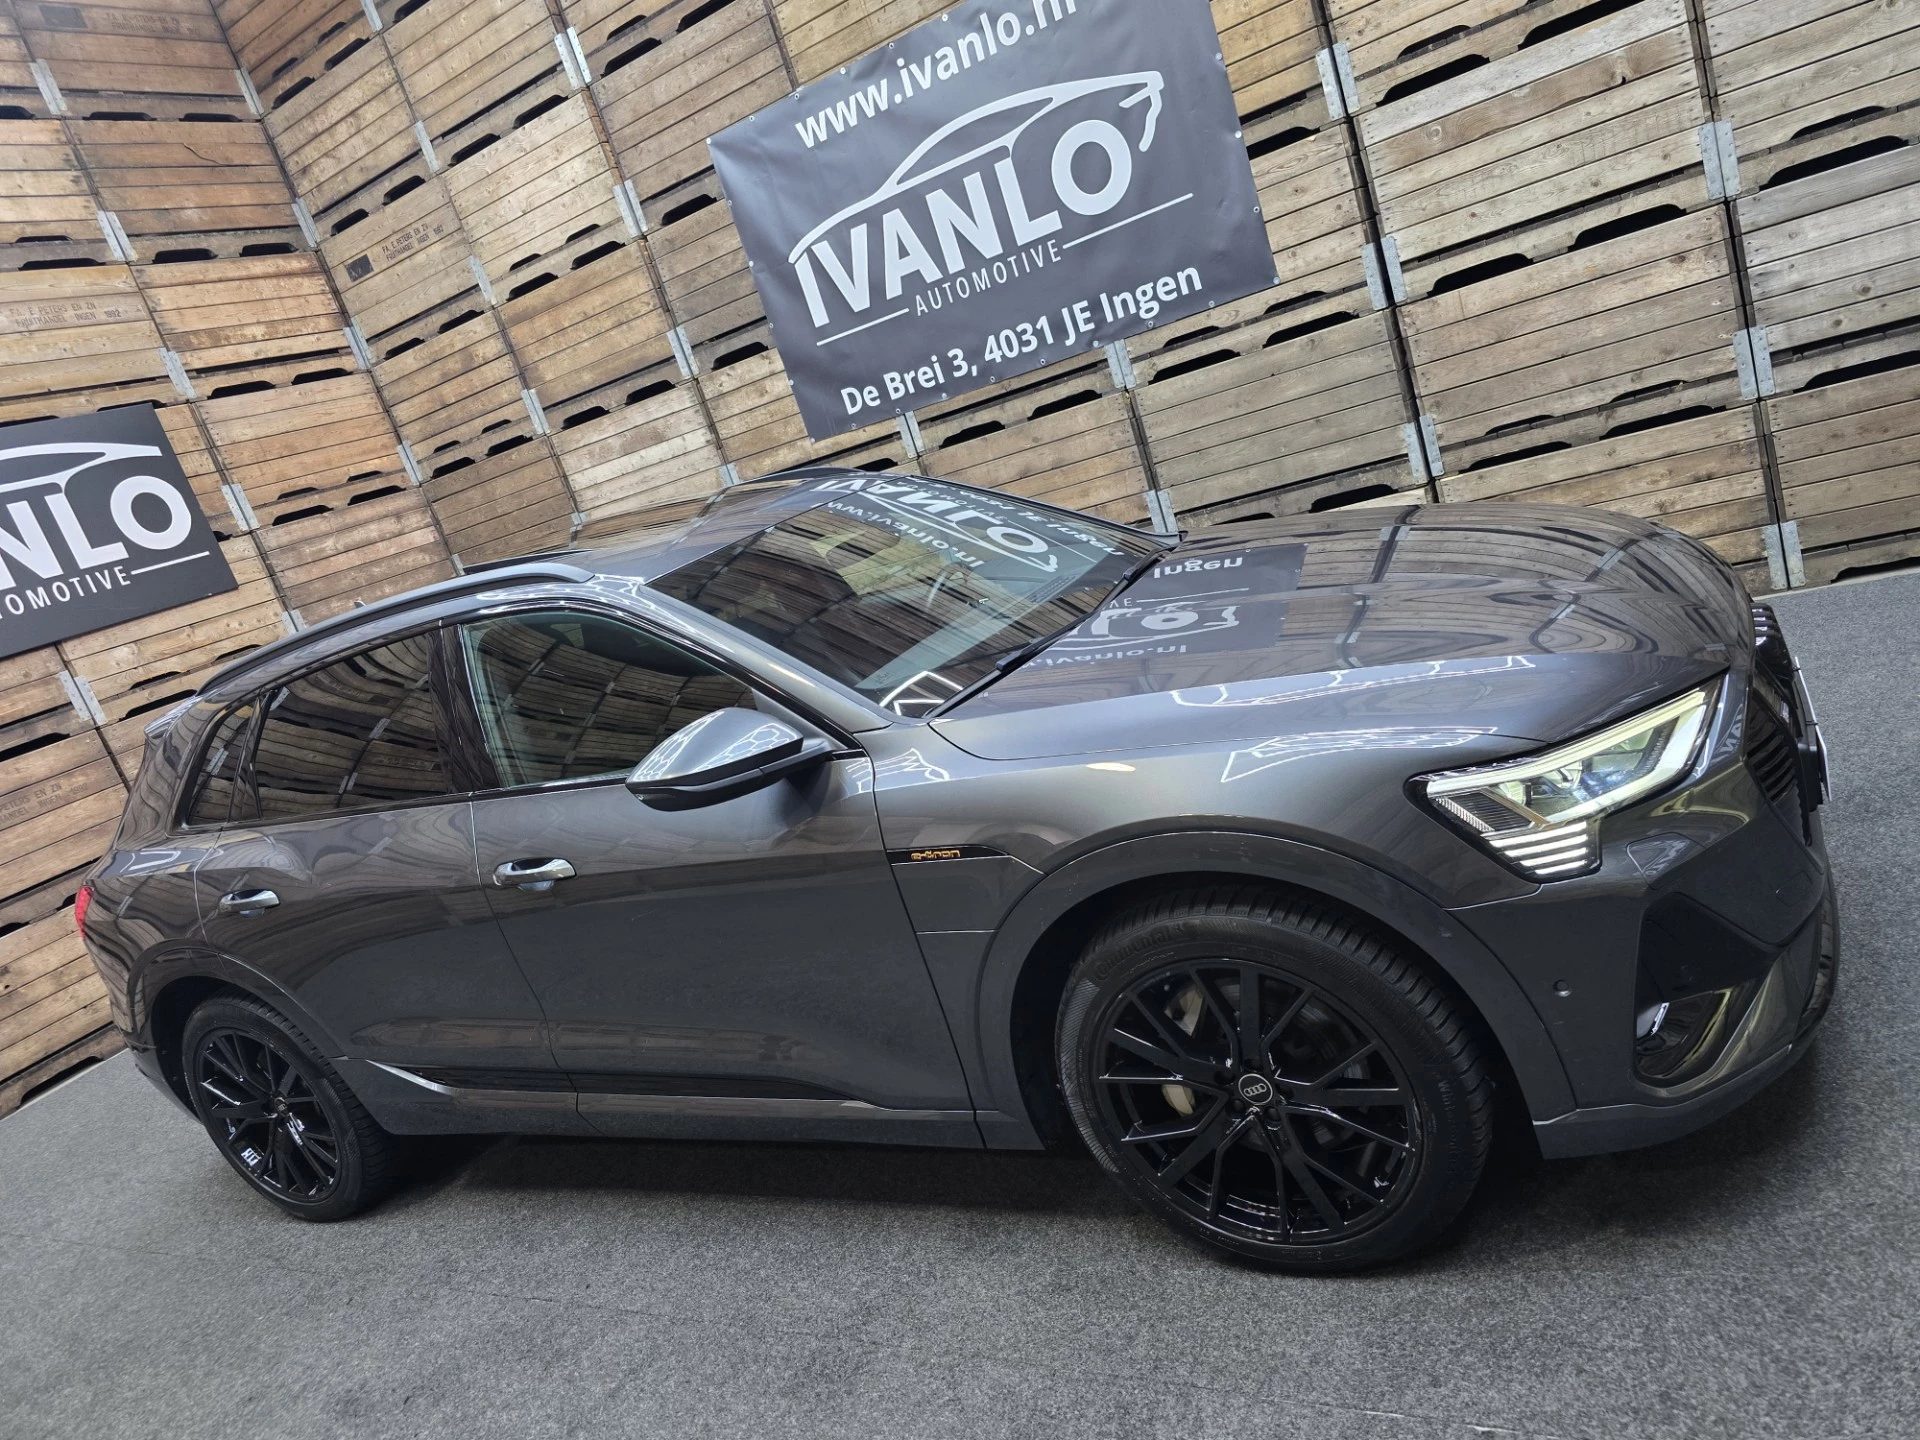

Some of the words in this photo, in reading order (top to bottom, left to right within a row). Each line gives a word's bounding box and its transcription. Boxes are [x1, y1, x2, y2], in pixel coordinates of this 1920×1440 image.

[794, 119, 1132, 328] IVANLO
[915, 239, 1062, 317] AUTOMOTIVE
[840, 386, 881, 415] De
[882, 354, 946, 401] Brei
[949, 347, 979, 377] 3,
[984, 316, 1055, 364] 4031
[1064, 300, 1095, 346] JE
[1100, 266, 1203, 321] Ingen
[0, 475, 192, 591] NLO
[0, 565, 131, 619] OMOTIVE
